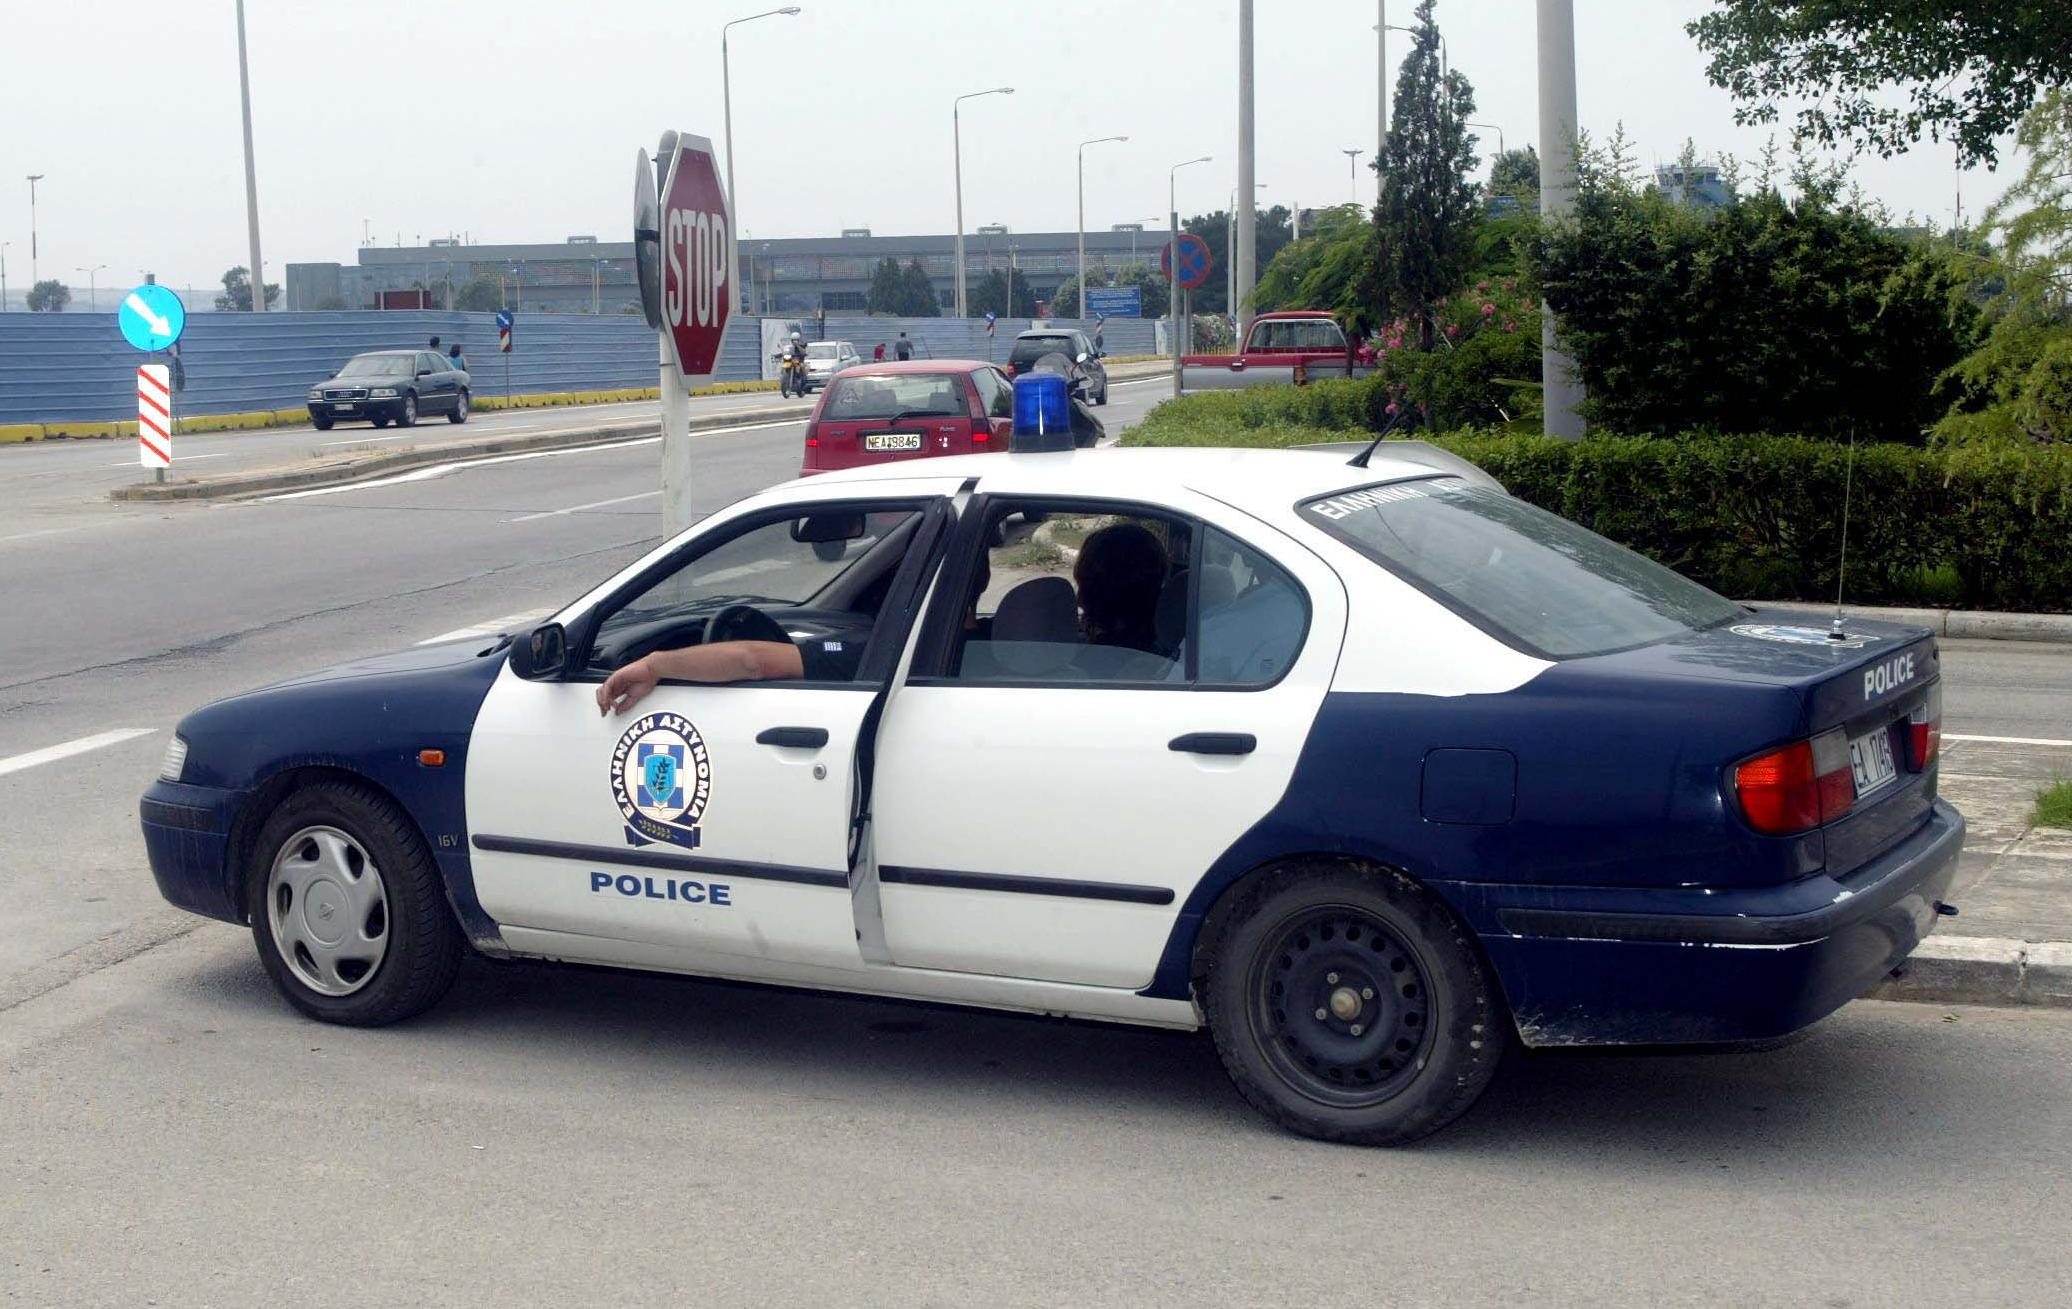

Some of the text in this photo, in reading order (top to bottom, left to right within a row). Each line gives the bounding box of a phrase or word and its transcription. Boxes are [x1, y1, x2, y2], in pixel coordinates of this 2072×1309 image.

[668, 208, 727, 328] STOP
[1864, 652, 1915, 701] POLICE
[612, 714, 710, 819] ΕΛΛΗΝΙΚΗ ΑΣΤΥΝΟΜΙΑ
[437, 834, 459, 848] 16V
[590, 871, 732, 907] POLICE
